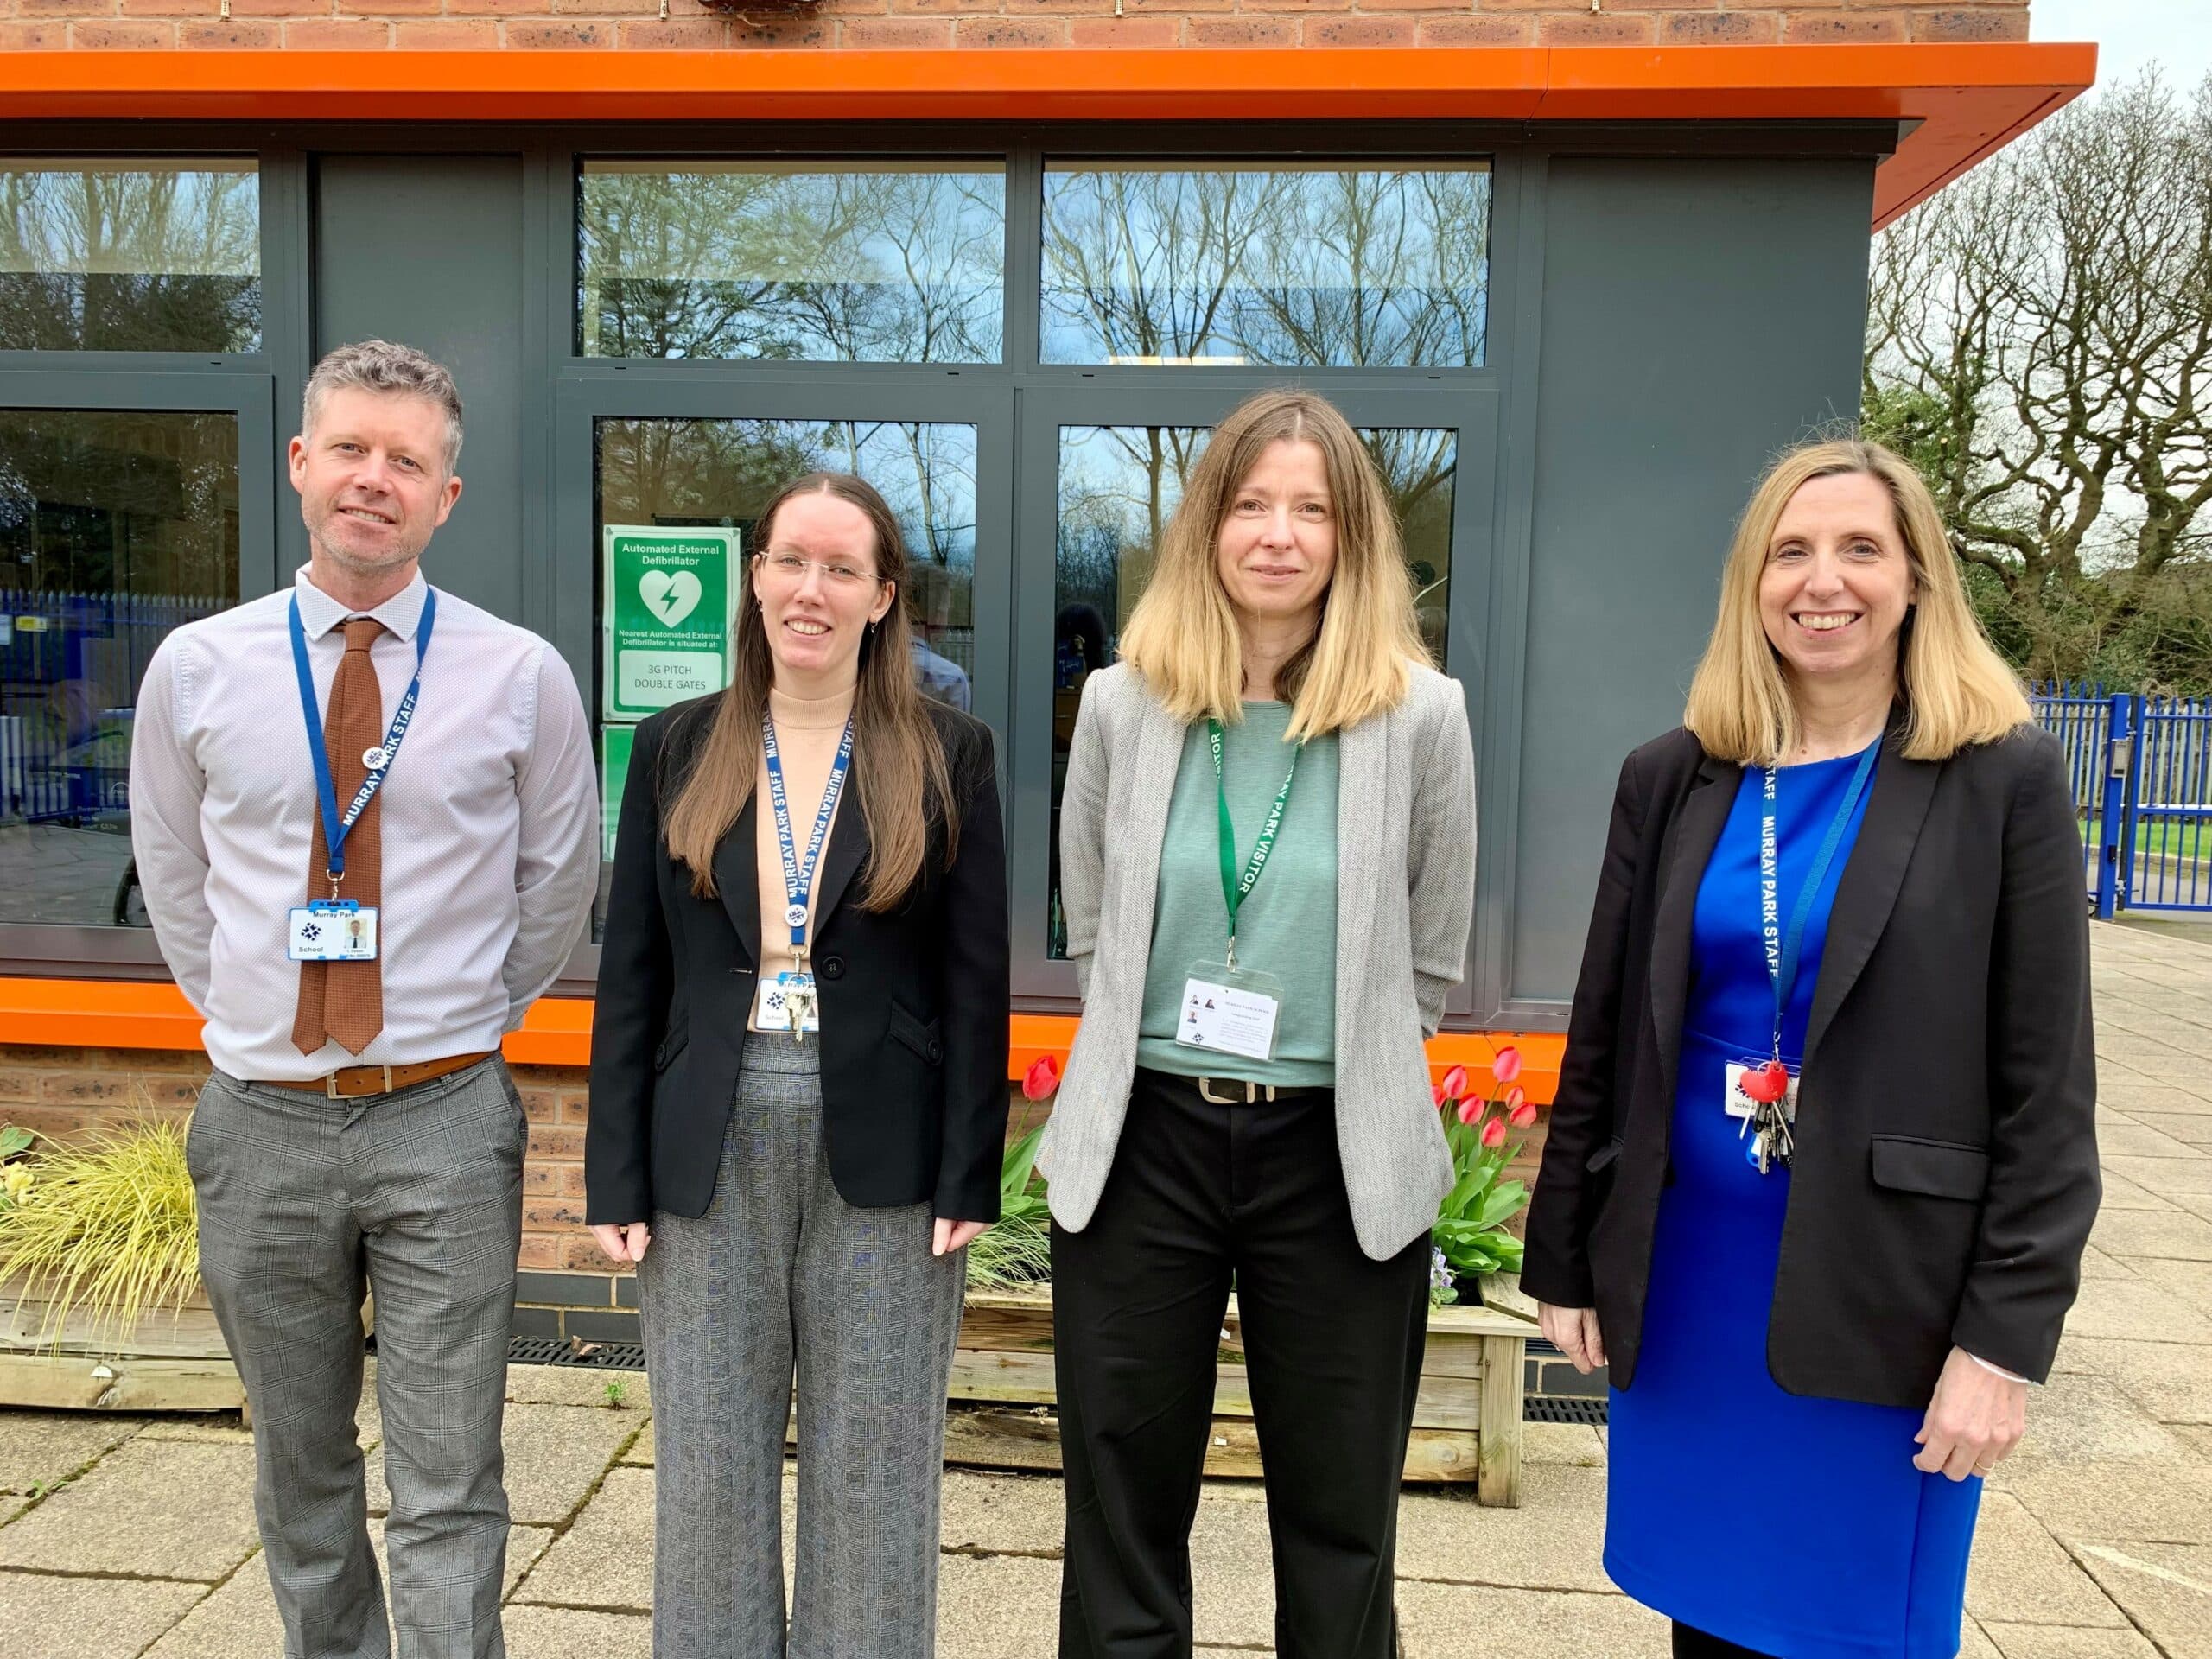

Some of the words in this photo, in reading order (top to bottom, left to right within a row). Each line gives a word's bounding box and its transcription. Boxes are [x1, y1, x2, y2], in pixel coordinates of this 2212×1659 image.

[622, 543, 677, 554] Automated
[679, 545, 719, 555] External
[642, 555, 700, 566] Defibrillator
[619, 629, 648, 638] Nearest
[650, 630, 690, 639] Automated
[692, 632, 722, 640] External
[634, 678, 673, 690] DOUBLE
[676, 680, 706, 690] GATES
[648, 664, 661, 675] 3G
[664, 665, 691, 675] PITCH
[343, 771, 381, 826] MURRAY
[392, 692, 416, 734] STAFF
[769, 770, 785, 807] STAFF
[819, 768, 843, 819] MURRAY
[1764, 768, 1777, 800] TAFF
[776, 808, 791, 842] PARK
[807, 820, 826, 853] PARK
[1262, 801, 1283, 837] PARK
[1762, 815, 1776, 877] MURRAY
[780, 844, 798, 898] MURRAY
[798, 855, 815, 895] STAFF
[1239, 840, 1271, 893] VISITOR
[1763, 880, 1777, 923] PARK
[1764, 926, 1778, 978] STAFF
